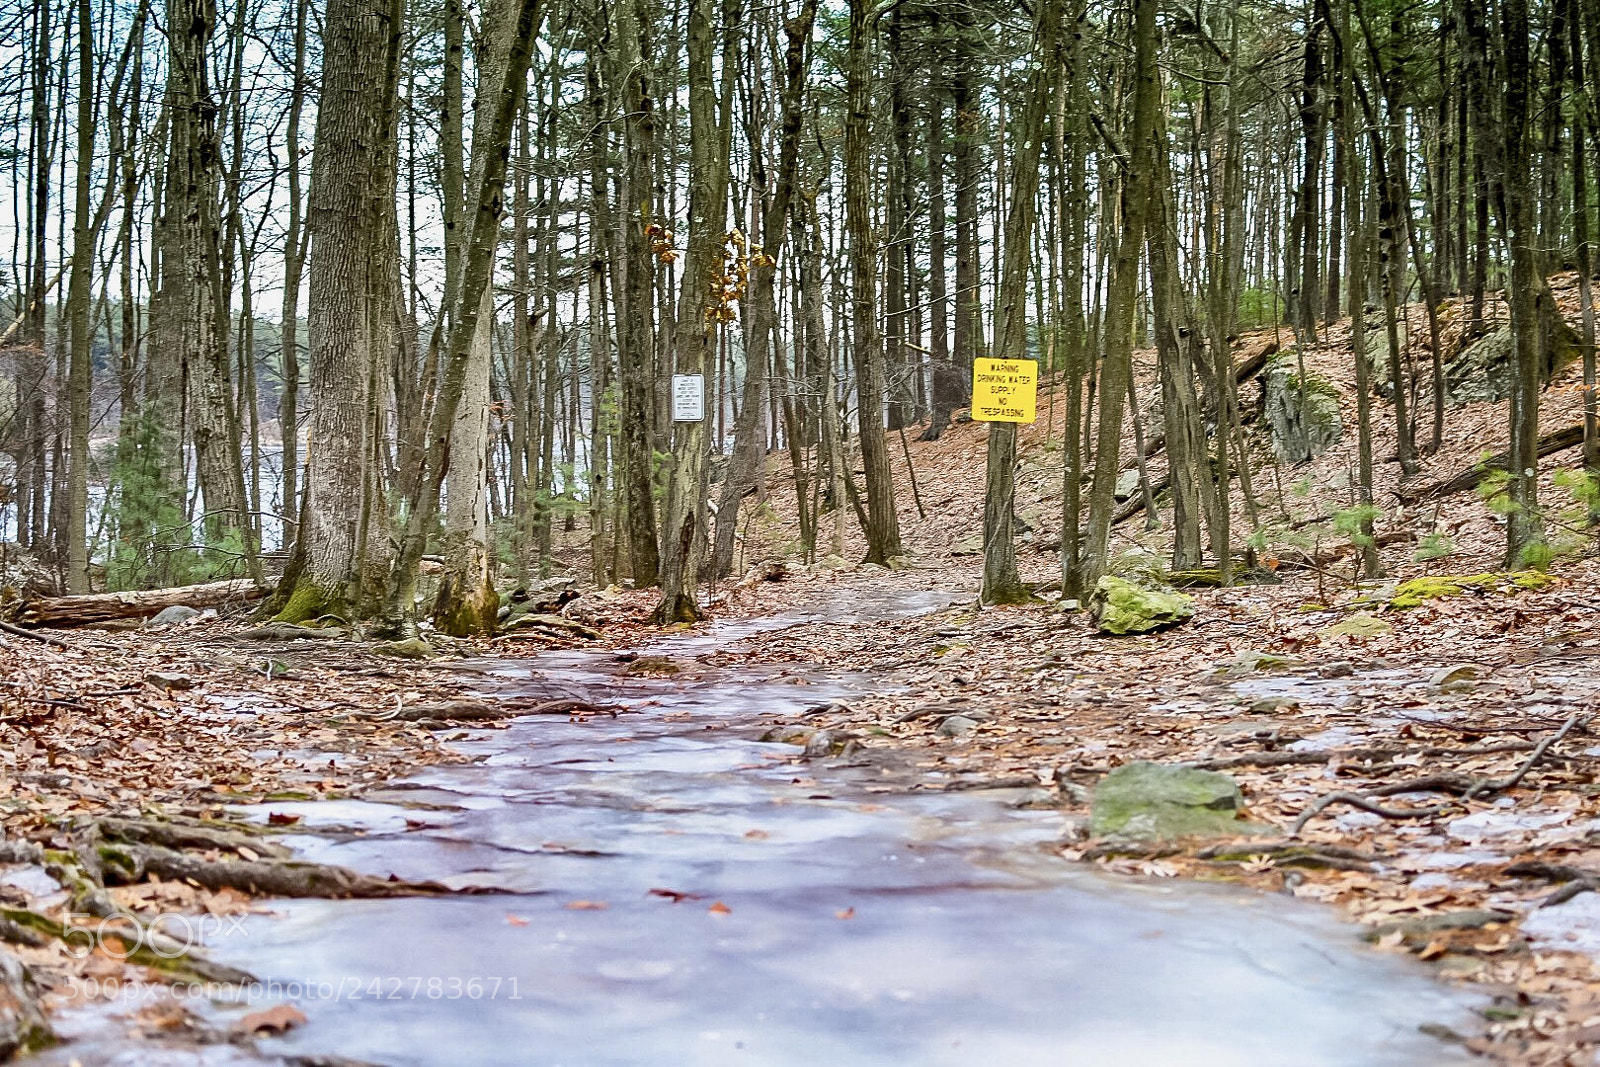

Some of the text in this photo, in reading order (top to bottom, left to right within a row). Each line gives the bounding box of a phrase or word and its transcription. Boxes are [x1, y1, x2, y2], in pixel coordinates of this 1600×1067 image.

[990, 364, 1019, 373] WARNING
[977, 374, 1031, 385] DRINKING WATER
[990, 385, 1017, 395] SUPPLY
[998, 397, 1008, 406] NO
[980, 407, 1025, 418] TRESPASSING
